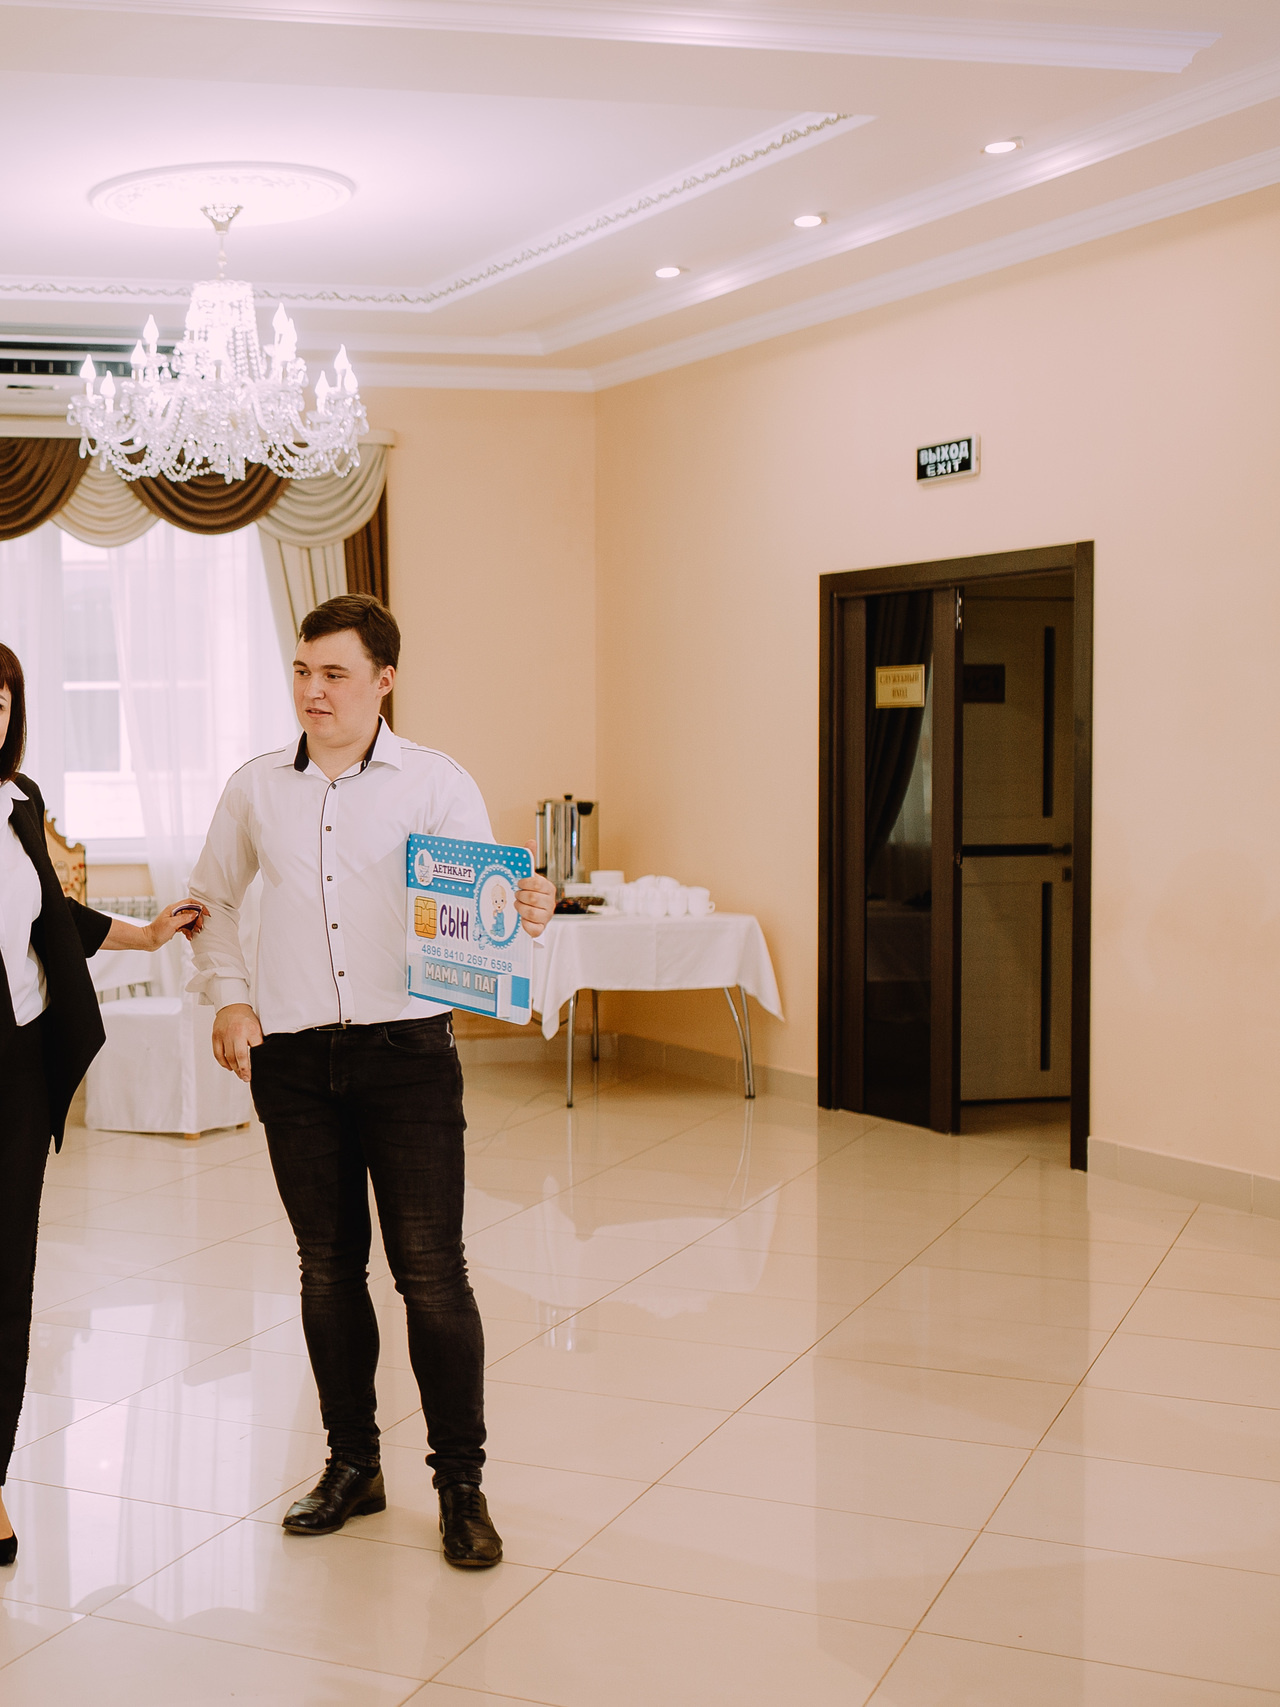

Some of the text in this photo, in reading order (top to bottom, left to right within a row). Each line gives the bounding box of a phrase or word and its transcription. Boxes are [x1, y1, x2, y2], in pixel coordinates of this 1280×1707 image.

[920, 440, 969, 465] ВЫХОД
[926, 459, 961, 477] EXIT
[440, 904, 469, 942] СЫН
[422, 944, 512, 973] 4896 8410 2697 6598
[425, 961, 459, 986] МАМА
[462, 970, 471, 989] И
